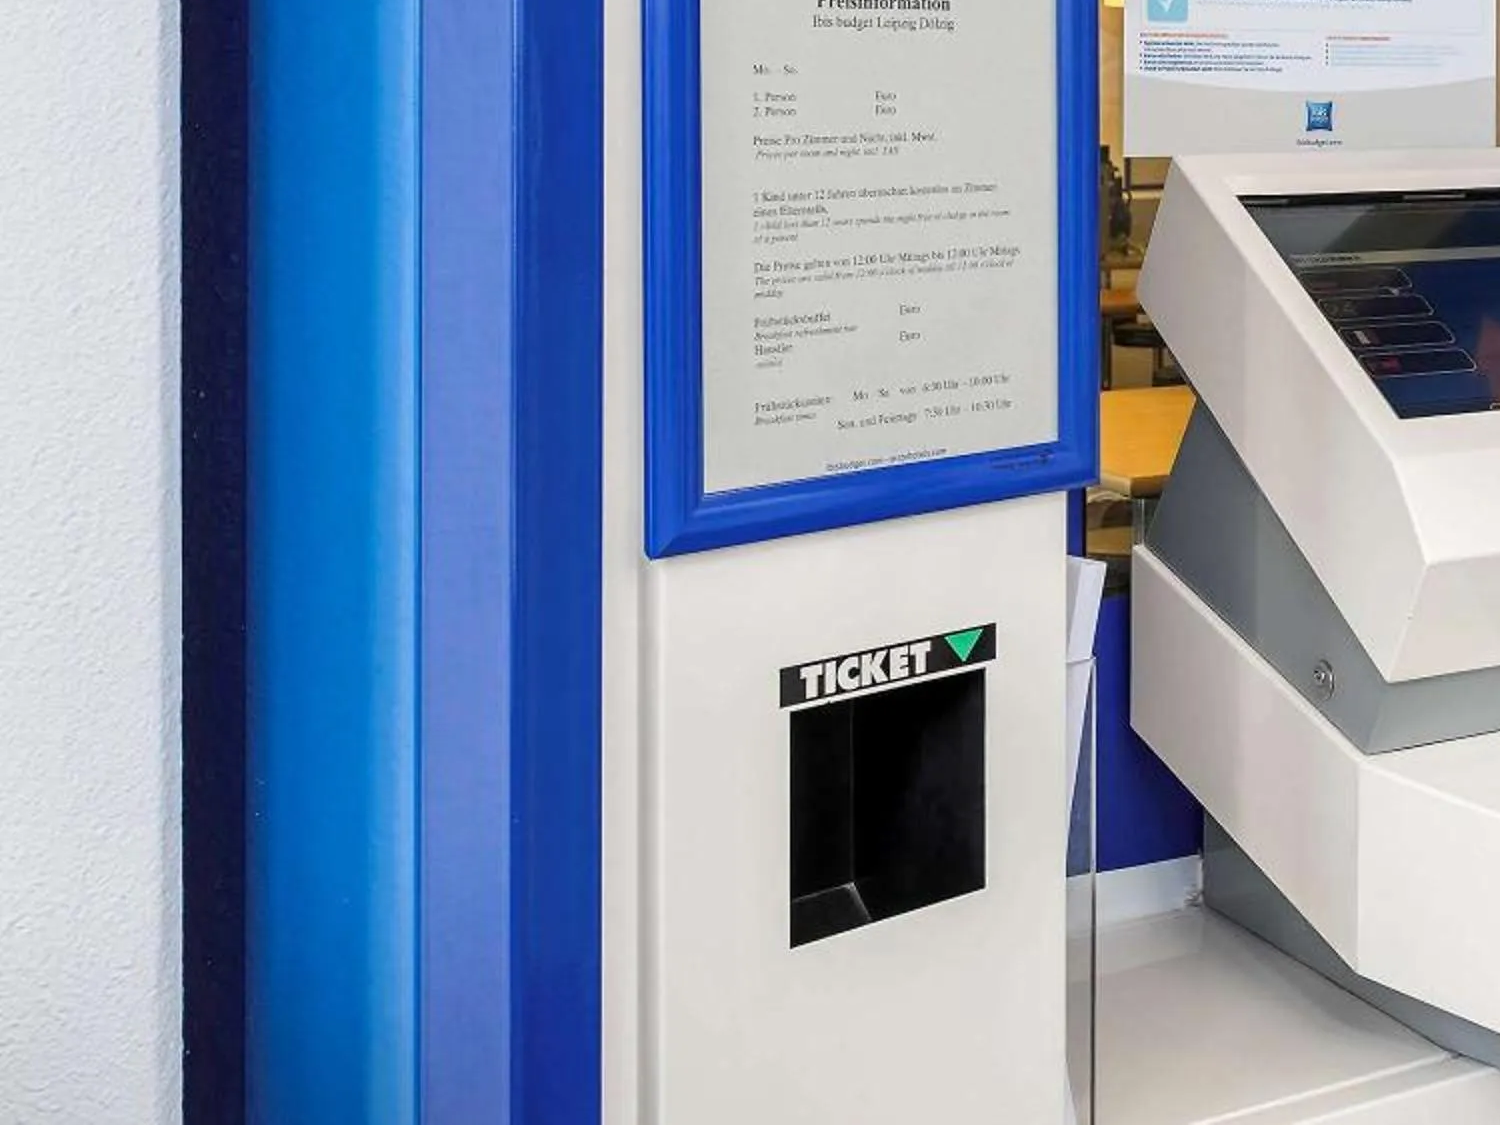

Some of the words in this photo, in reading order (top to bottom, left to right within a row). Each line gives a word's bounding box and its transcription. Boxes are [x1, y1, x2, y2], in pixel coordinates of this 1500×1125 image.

[813, 14, 833, 28] Ibis
[836, 15, 873, 32] budget
[877, 16, 917, 32] Leipzig
[764, 92, 797, 103] Person
[875, 90, 897, 101] Euro
[764, 106, 797, 117] Person
[875, 104, 897, 115] Euro
[800, 640, 932, 700] TICKET
